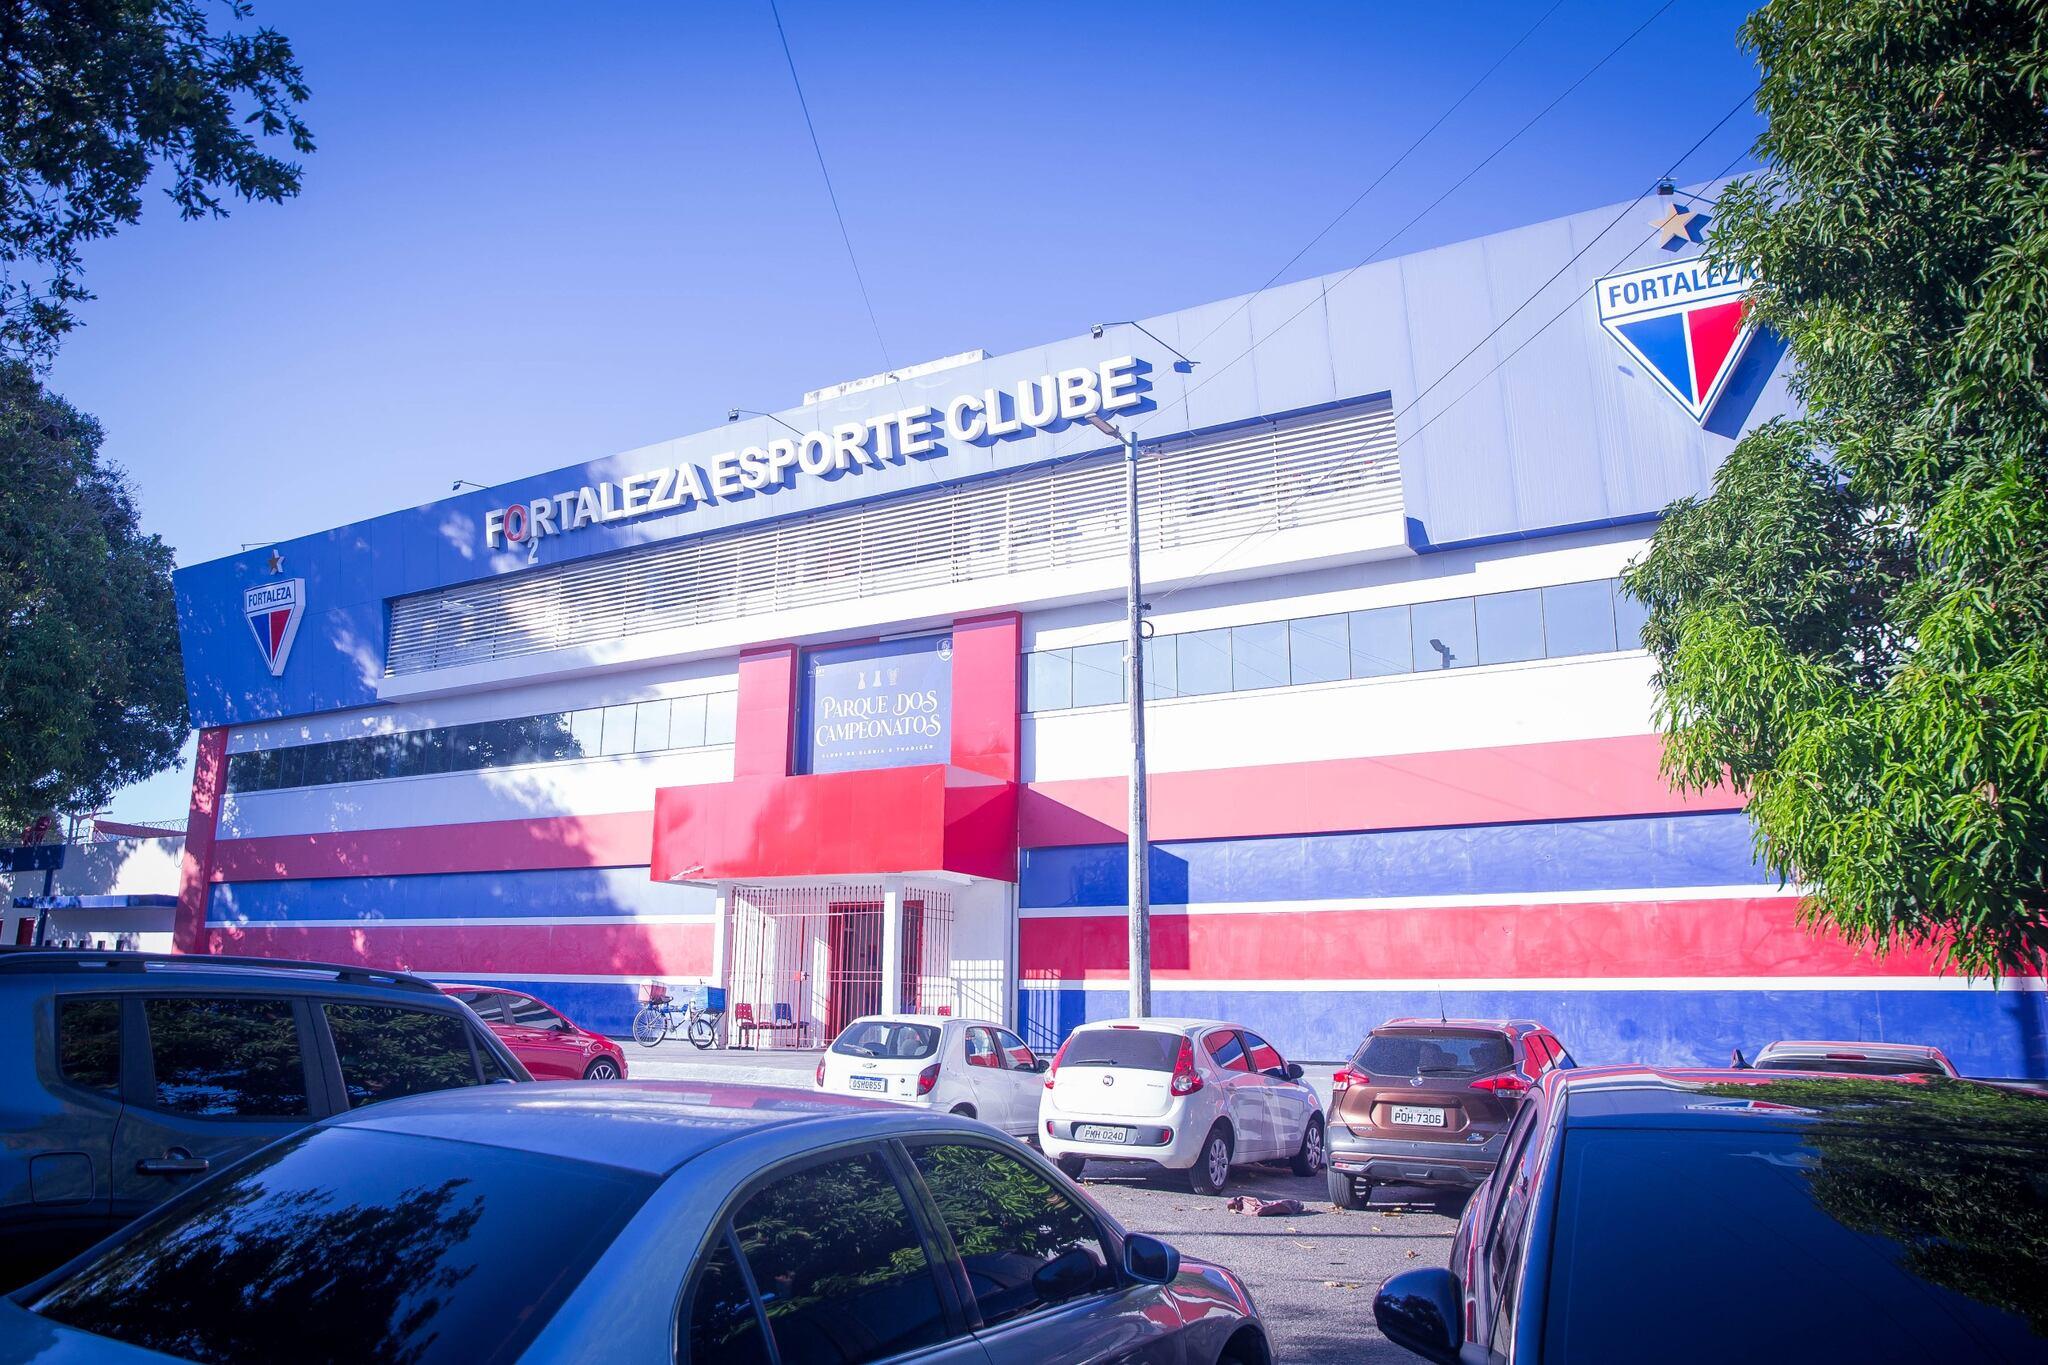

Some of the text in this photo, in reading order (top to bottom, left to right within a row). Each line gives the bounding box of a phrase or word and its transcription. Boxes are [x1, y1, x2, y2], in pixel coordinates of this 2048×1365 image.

[485, 354, 1142, 548] FORTALEZA ESPORTE CLUBE
[248, 586, 292, 607] FORTALEZA
[821, 690, 938, 720] PARQUE DOS
[815, 714, 941, 747] CAMPEONATOS
